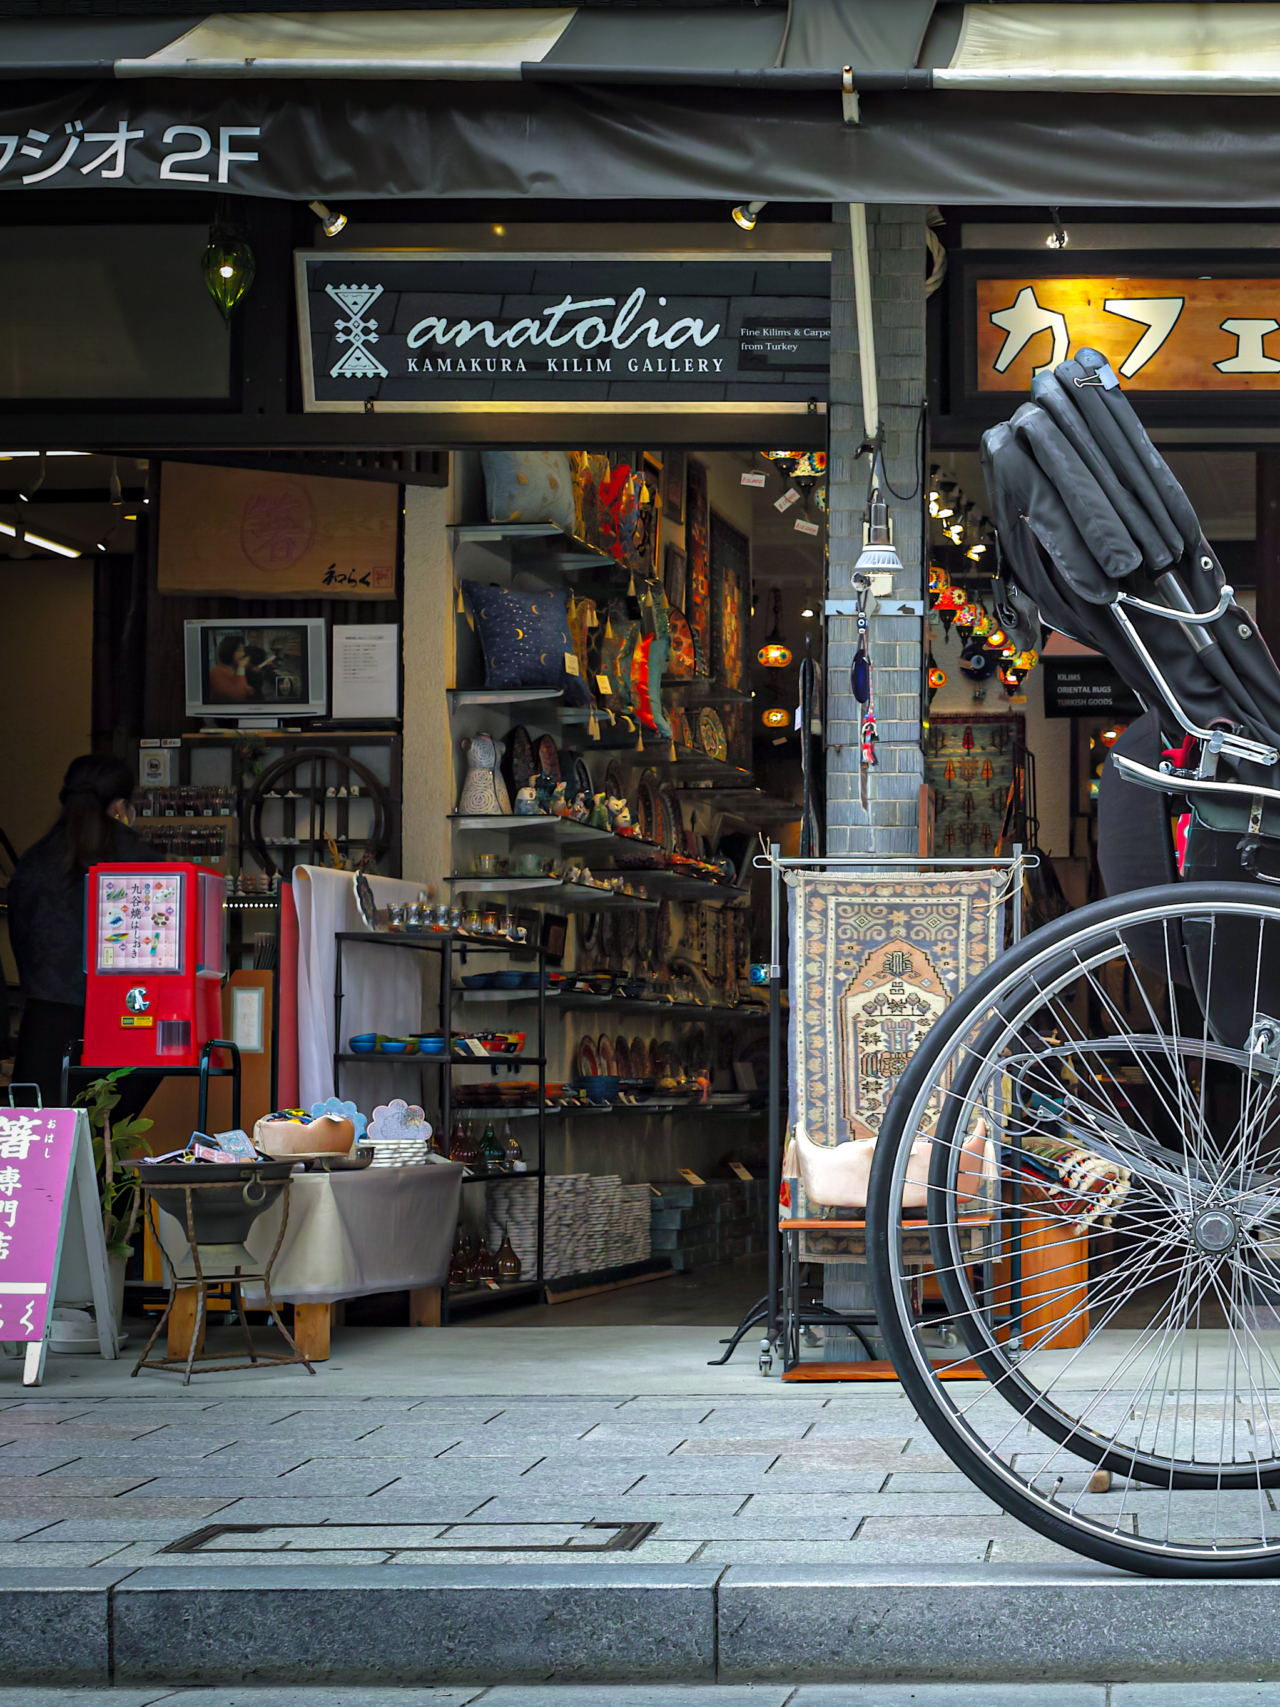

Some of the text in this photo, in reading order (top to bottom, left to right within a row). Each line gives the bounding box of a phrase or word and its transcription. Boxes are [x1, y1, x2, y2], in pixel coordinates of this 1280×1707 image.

[159, 125, 260, 183] 2F
[406, 287, 721, 350] anatolia
[740, 328, 760, 336] Fine
[762, 328, 791, 336] Kilims
[793, 328, 801, 336] &
[741, 342, 798, 352] from Turkey
[407, 358, 724, 373] KAMAKURA KILIM GALLERY
[1057, 673, 1081, 681] KILIMS
[1057, 685, 1112, 694] ORIENTAL RUGS
[1057, 698, 1113, 706] TURKISH GOODS
[44, 1118, 56, 1158] おはし
